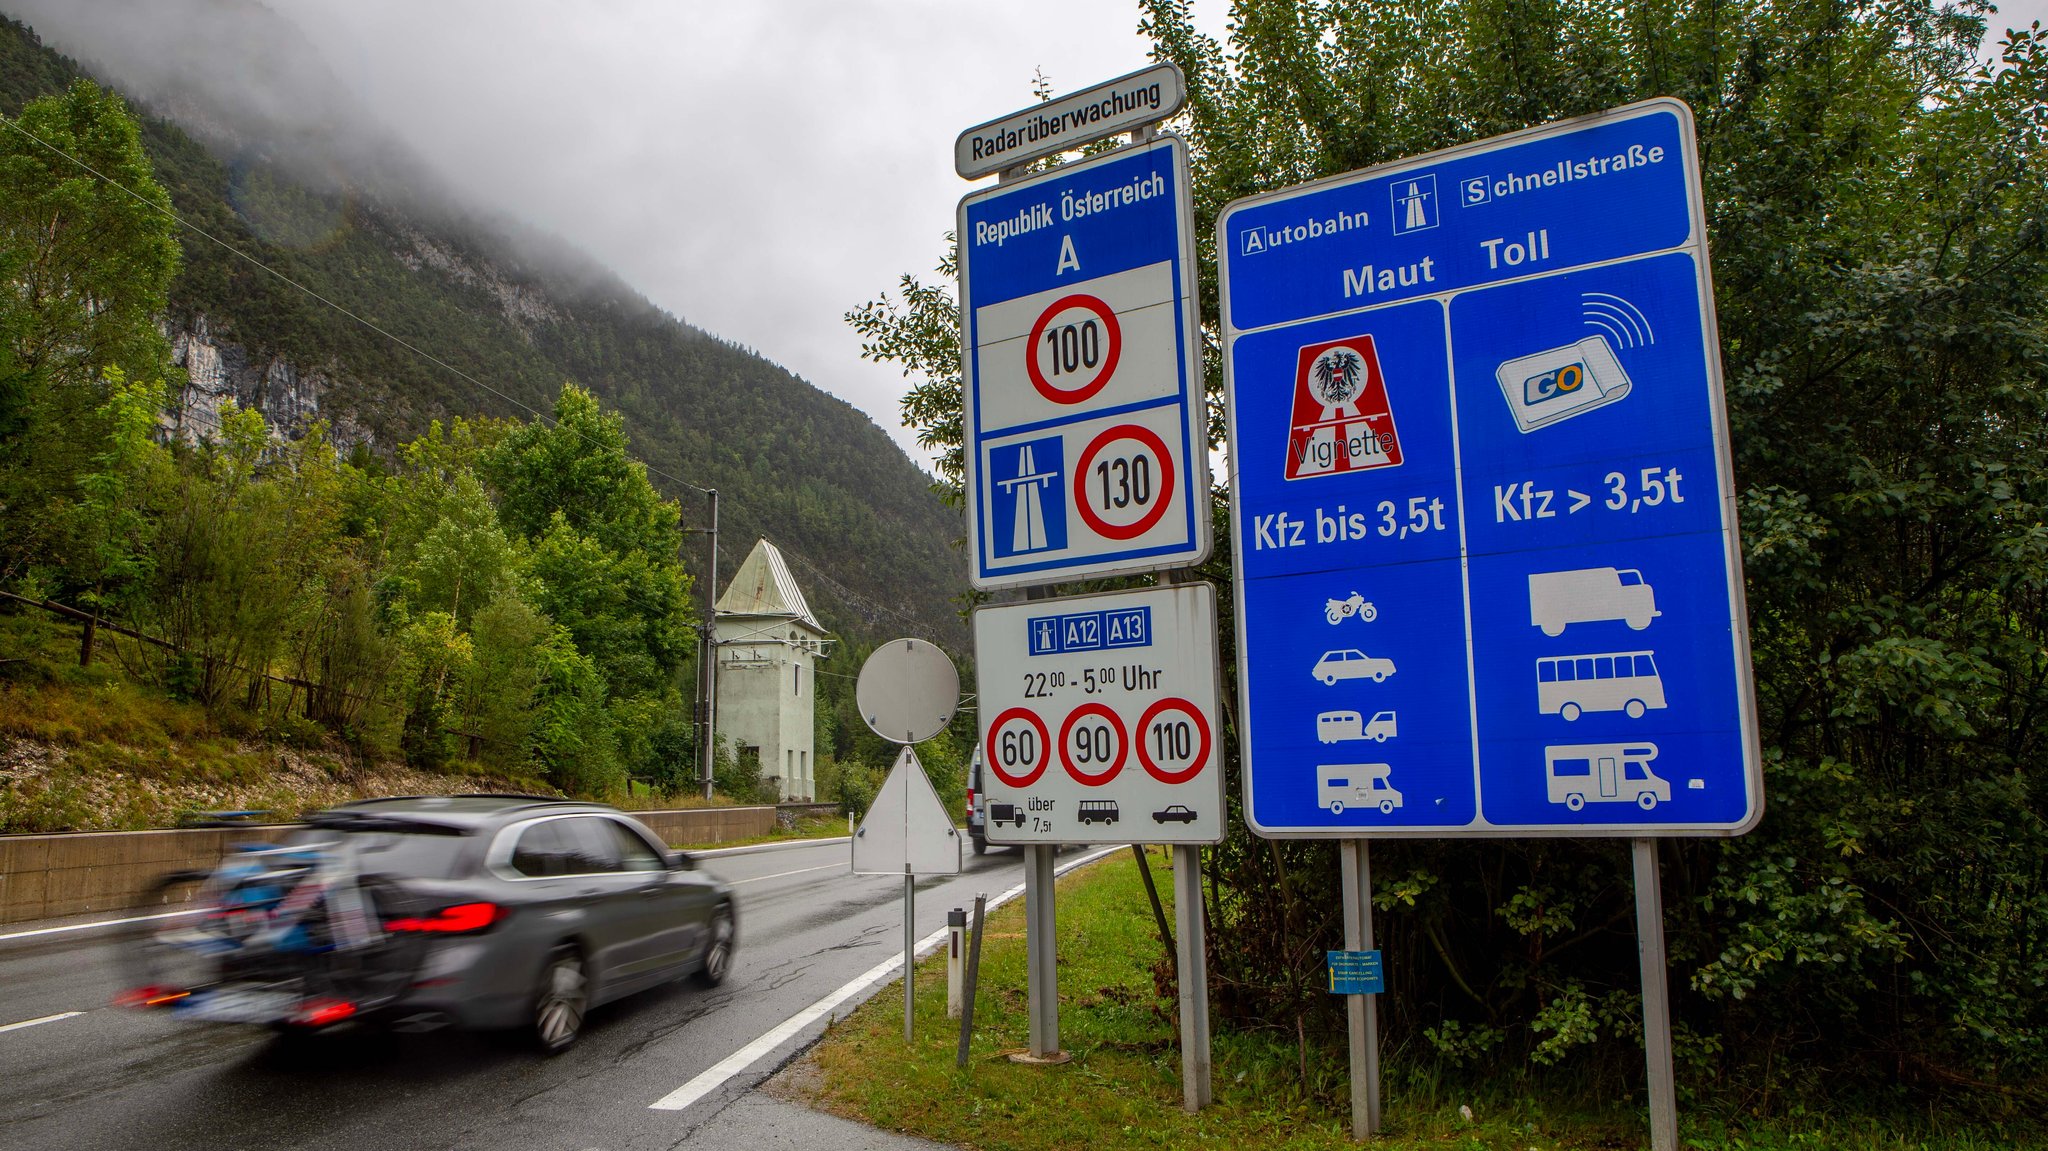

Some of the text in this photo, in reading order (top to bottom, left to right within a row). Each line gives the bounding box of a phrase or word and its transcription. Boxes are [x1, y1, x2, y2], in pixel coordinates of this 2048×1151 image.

[972, 82, 1160, 161] Radarüberwachung
[1465, 143, 1665, 203] Schnellstraße
[976, 171, 1165, 247] Republik Österreich
[1244, 208, 1370, 254] Autobahn
[1056, 234, 1081, 276] A
[1343, 229, 1550, 298] Maut Toll
[1047, 320, 1099, 376] 100
[1528, 365, 1583, 402] GO
[1292, 429, 1394, 468] Vignette
[1097, 454, 1151, 510] 130
[1494, 481, 1556, 523] Kfz
[1604, 467, 1684, 514] 3,5t
[1254, 497, 1446, 551] Kfz bis 3,5t
[1066, 614, 1142, 645] A12 A13
[1122, 664, 1162, 691] Uhr
[1002, 729, 1034, 766] 60
[1075, 725, 1111, 763] 90
[1153, 721, 1191, 761] 110
[1028, 796, 1055, 812] über
[1033, 817, 1051, 833] 7,5t
